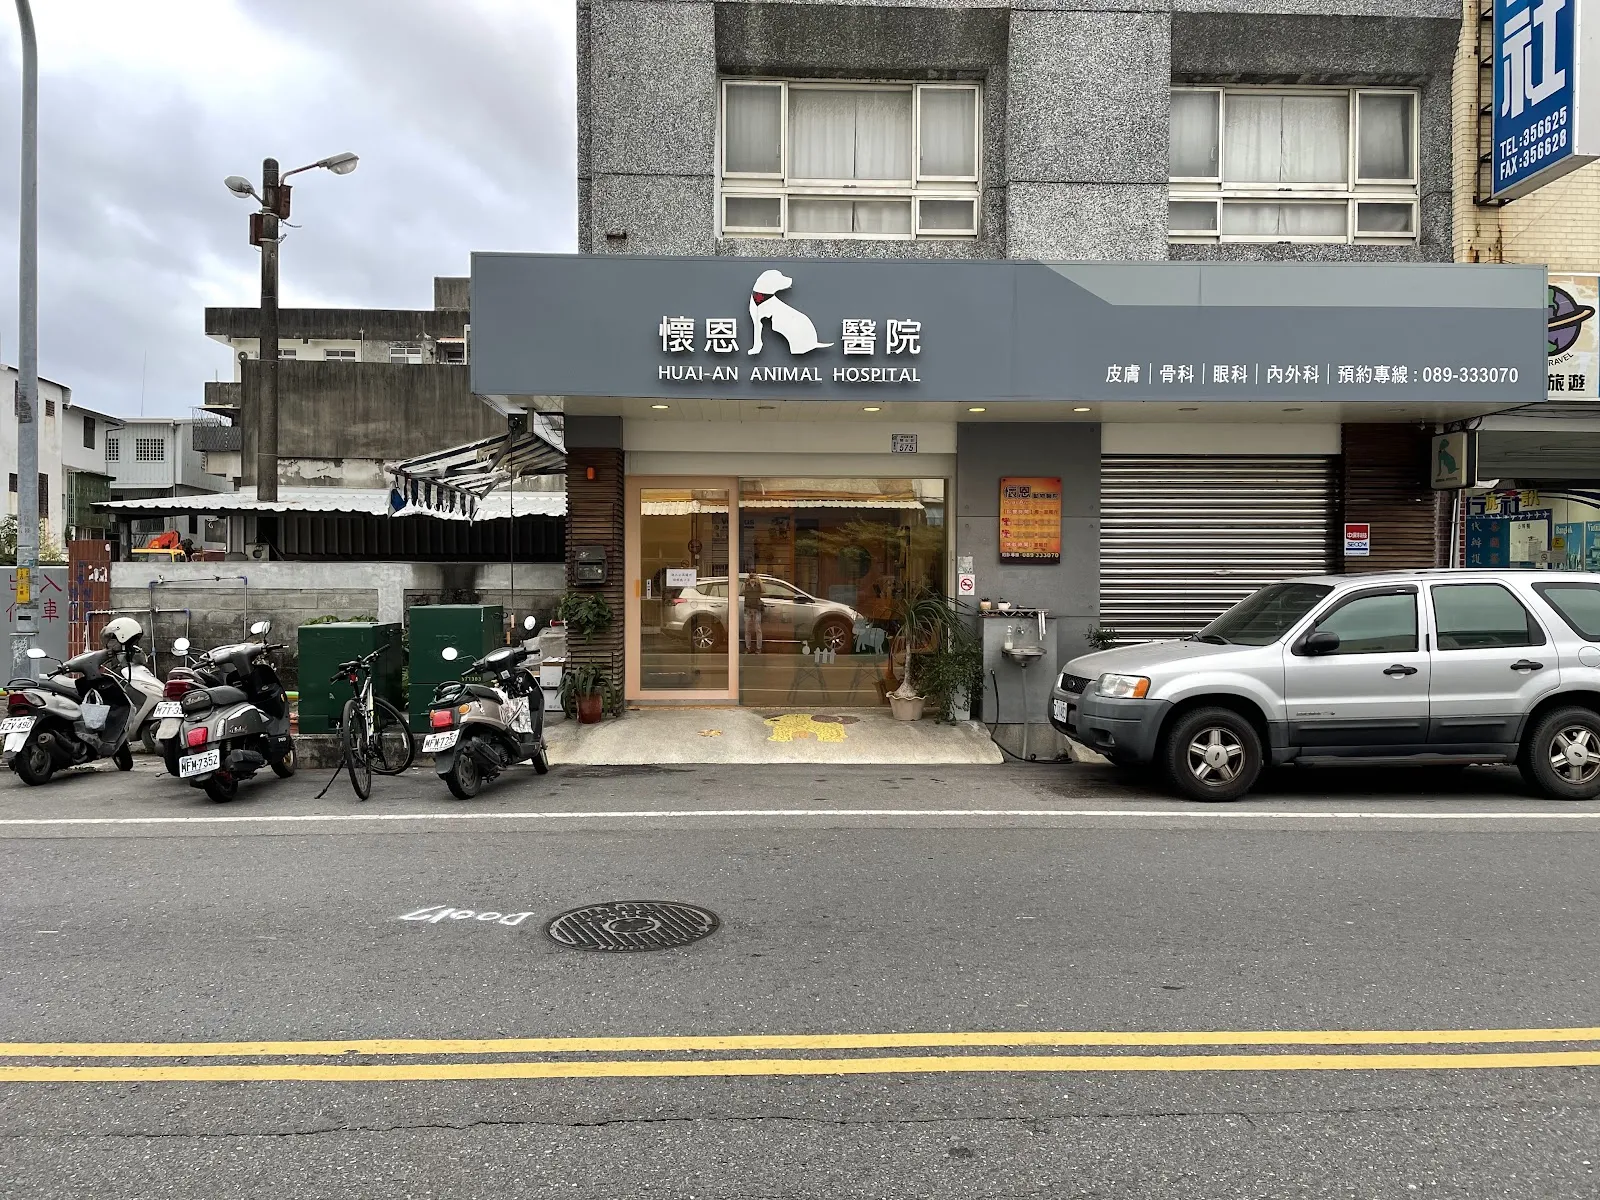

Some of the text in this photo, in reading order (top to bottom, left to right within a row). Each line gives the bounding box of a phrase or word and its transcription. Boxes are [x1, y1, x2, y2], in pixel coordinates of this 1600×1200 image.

[658, 315, 922, 355] 懷恩 醫院
[1548, 353, 1574, 366] RAVEL
[658, 365, 921, 382] HUAI-AN ANIMAL HOSPITAL
[1159, 364, 1195, 384] 骨科
[1213, 364, 1248, 384] 眼科
